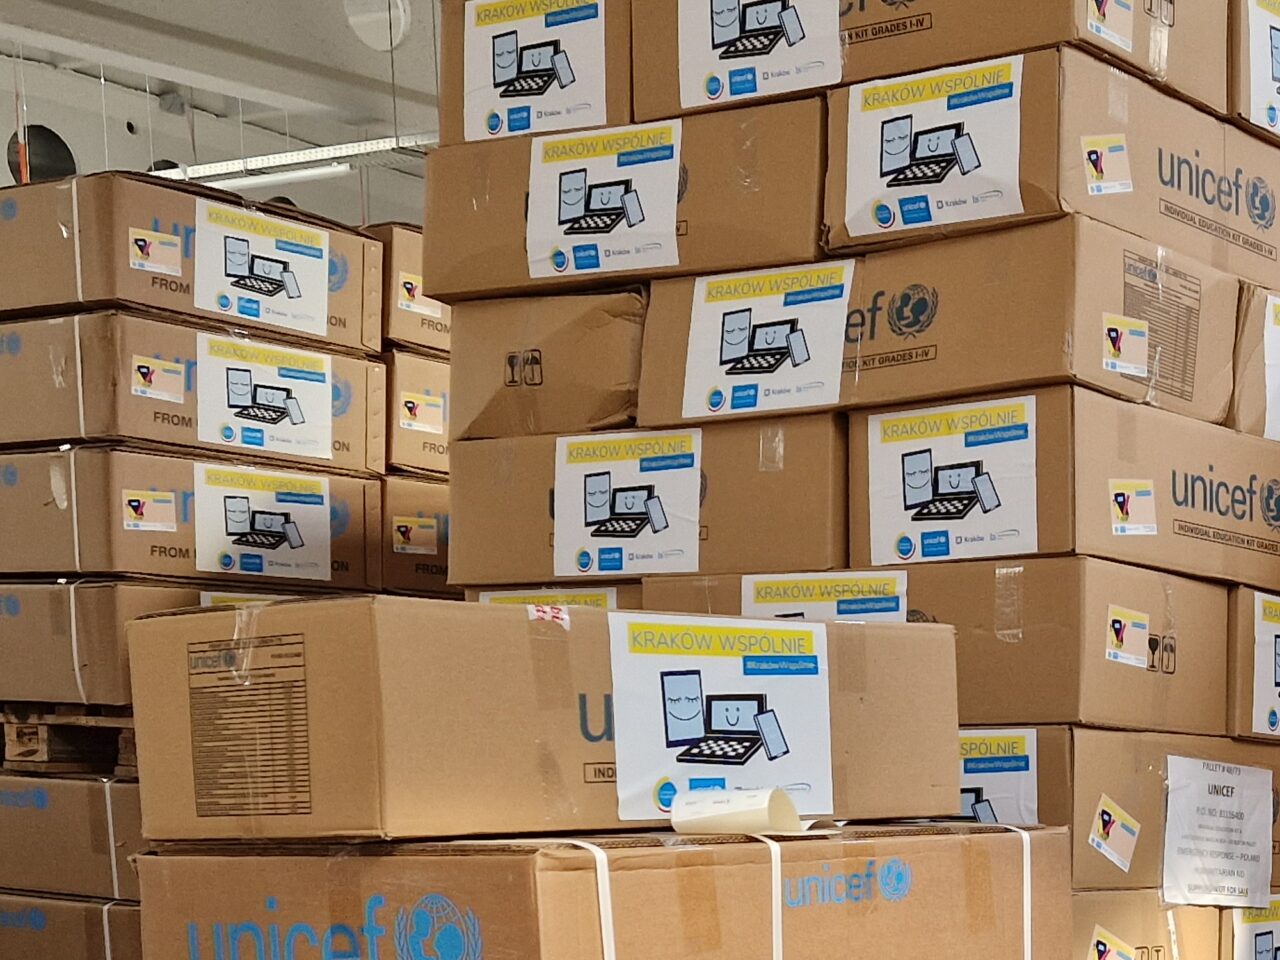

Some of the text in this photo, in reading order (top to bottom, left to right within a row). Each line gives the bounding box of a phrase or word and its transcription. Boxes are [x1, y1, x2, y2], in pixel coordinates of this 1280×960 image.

[855, 27, 870, 39] KIT
[871, 20, 908, 37] GRADES
[863, 69, 1005, 107] KRAKÓW WSPÓLNIE
[544, 131, 667, 161] KRAKÓW WSPÓLNIE
[1157, 147, 1243, 217] unicef
[1164, 204, 1198, 225] INDIVIDUAL
[1198, 214, 1231, 238] EDUCATION
[1241, 235, 1264, 252] GRADES
[151, 276, 191, 296] FROM
[707, 271, 837, 301] KRAKÓW WSPÓLNIE
[877, 353, 914, 366] GRADES
[153, 411, 193, 430] FROM
[882, 409, 1019, 440] KRAKÓW WSPÓLNIE
[569, 439, 688, 460] KRAKÓW WSPÓLNIE
[1172, 464, 1258, 522] unicef
[1178, 524, 1212, 538] INDIVIDUAL
[1213, 531, 1246, 545] EDUCATION
[1256, 541, 1279, 553] GRADES
[150, 547, 190, 562] FROM
[756, 580, 891, 600] KRAKÓW WSPÓLNIE
[632, 629, 808, 655] KRAKÓW WSPÓLNIE
[961, 738, 1018, 756] SPÓLNIE
[1202, 761, 1220, 773] PALLET
[1208, 783, 1236, 798] UNICEF
[784, 860, 876, 908] unicef
